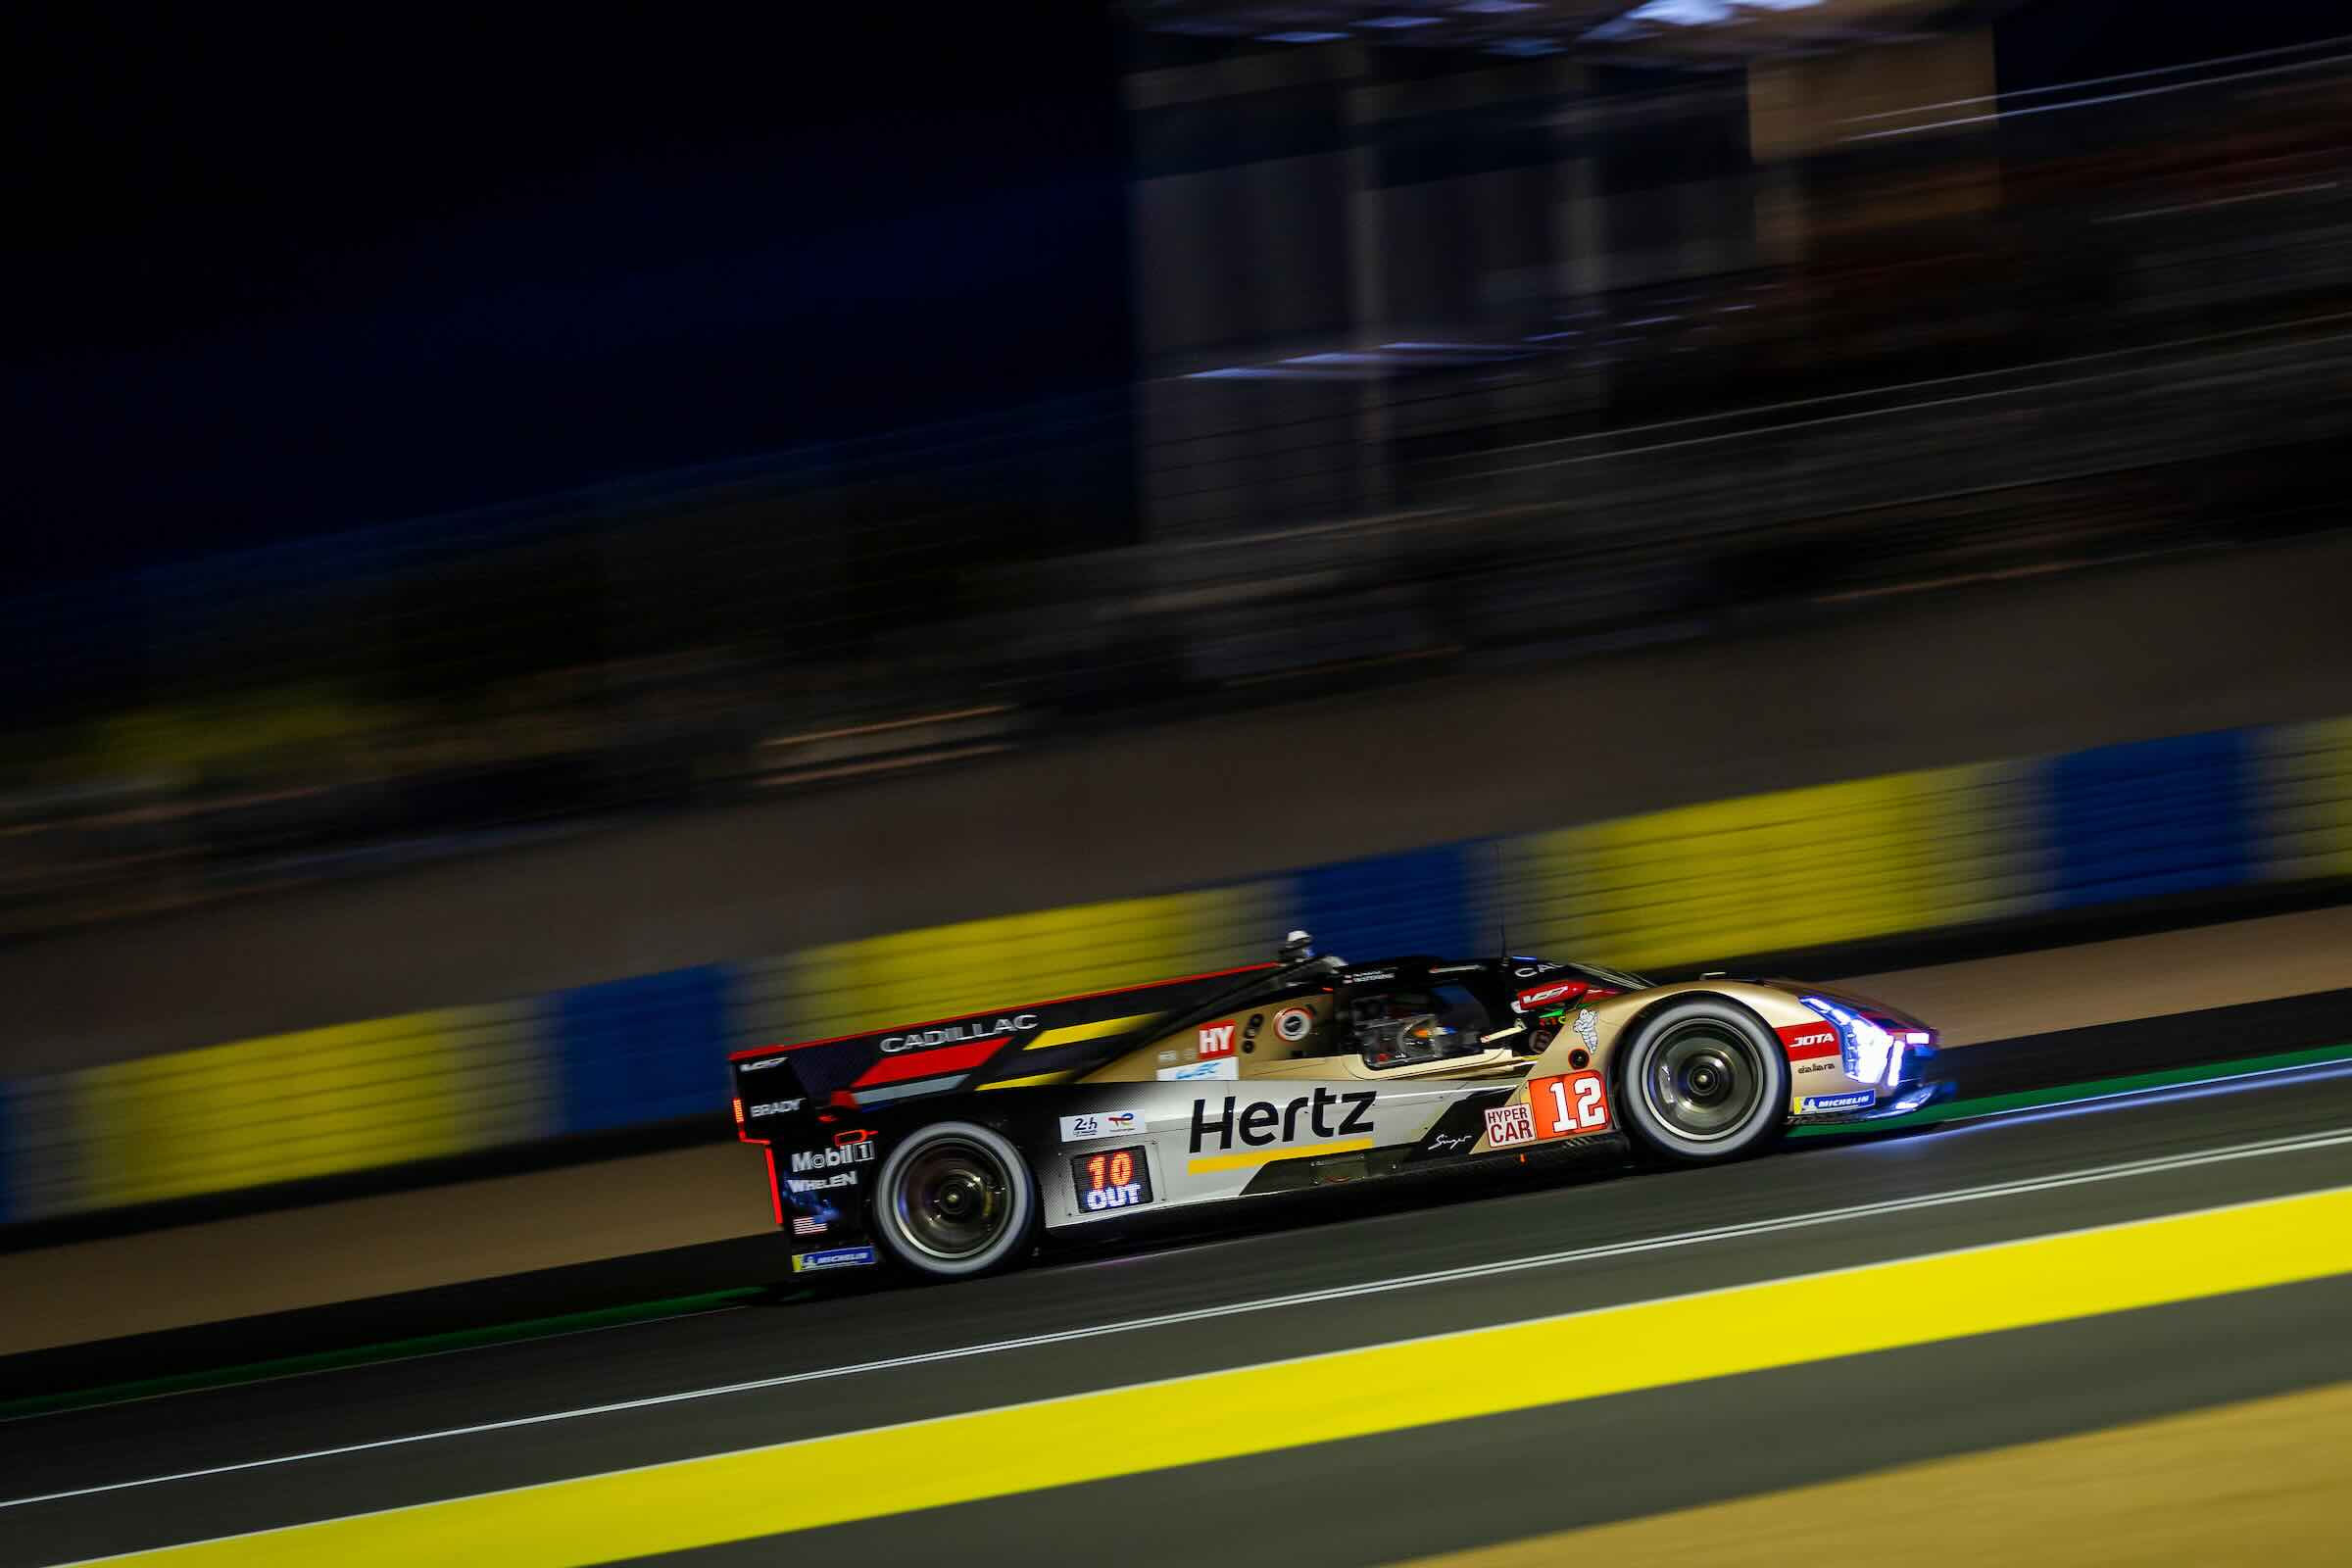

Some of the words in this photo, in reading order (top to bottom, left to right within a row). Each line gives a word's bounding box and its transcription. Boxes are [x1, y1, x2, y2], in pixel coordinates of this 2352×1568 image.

[880, 1014, 1039, 1053] CADILLAC
[1199, 1025, 1235, 1054] HY
[1788, 1033, 1835, 1048] JOTA
[1488, 1106, 1529, 1125] HYPER
[1548, 1076, 1607, 1134] 12
[1818, 1095, 1870, 1107] MICHELIN
[1189, 1088, 1377, 1153] Hertz
[1491, 1119, 1534, 1145] CAR
[791, 1144, 853, 1173] Mobil
[1088, 1152, 1132, 1192] 10
[1086, 1183, 1142, 1211] OUT
